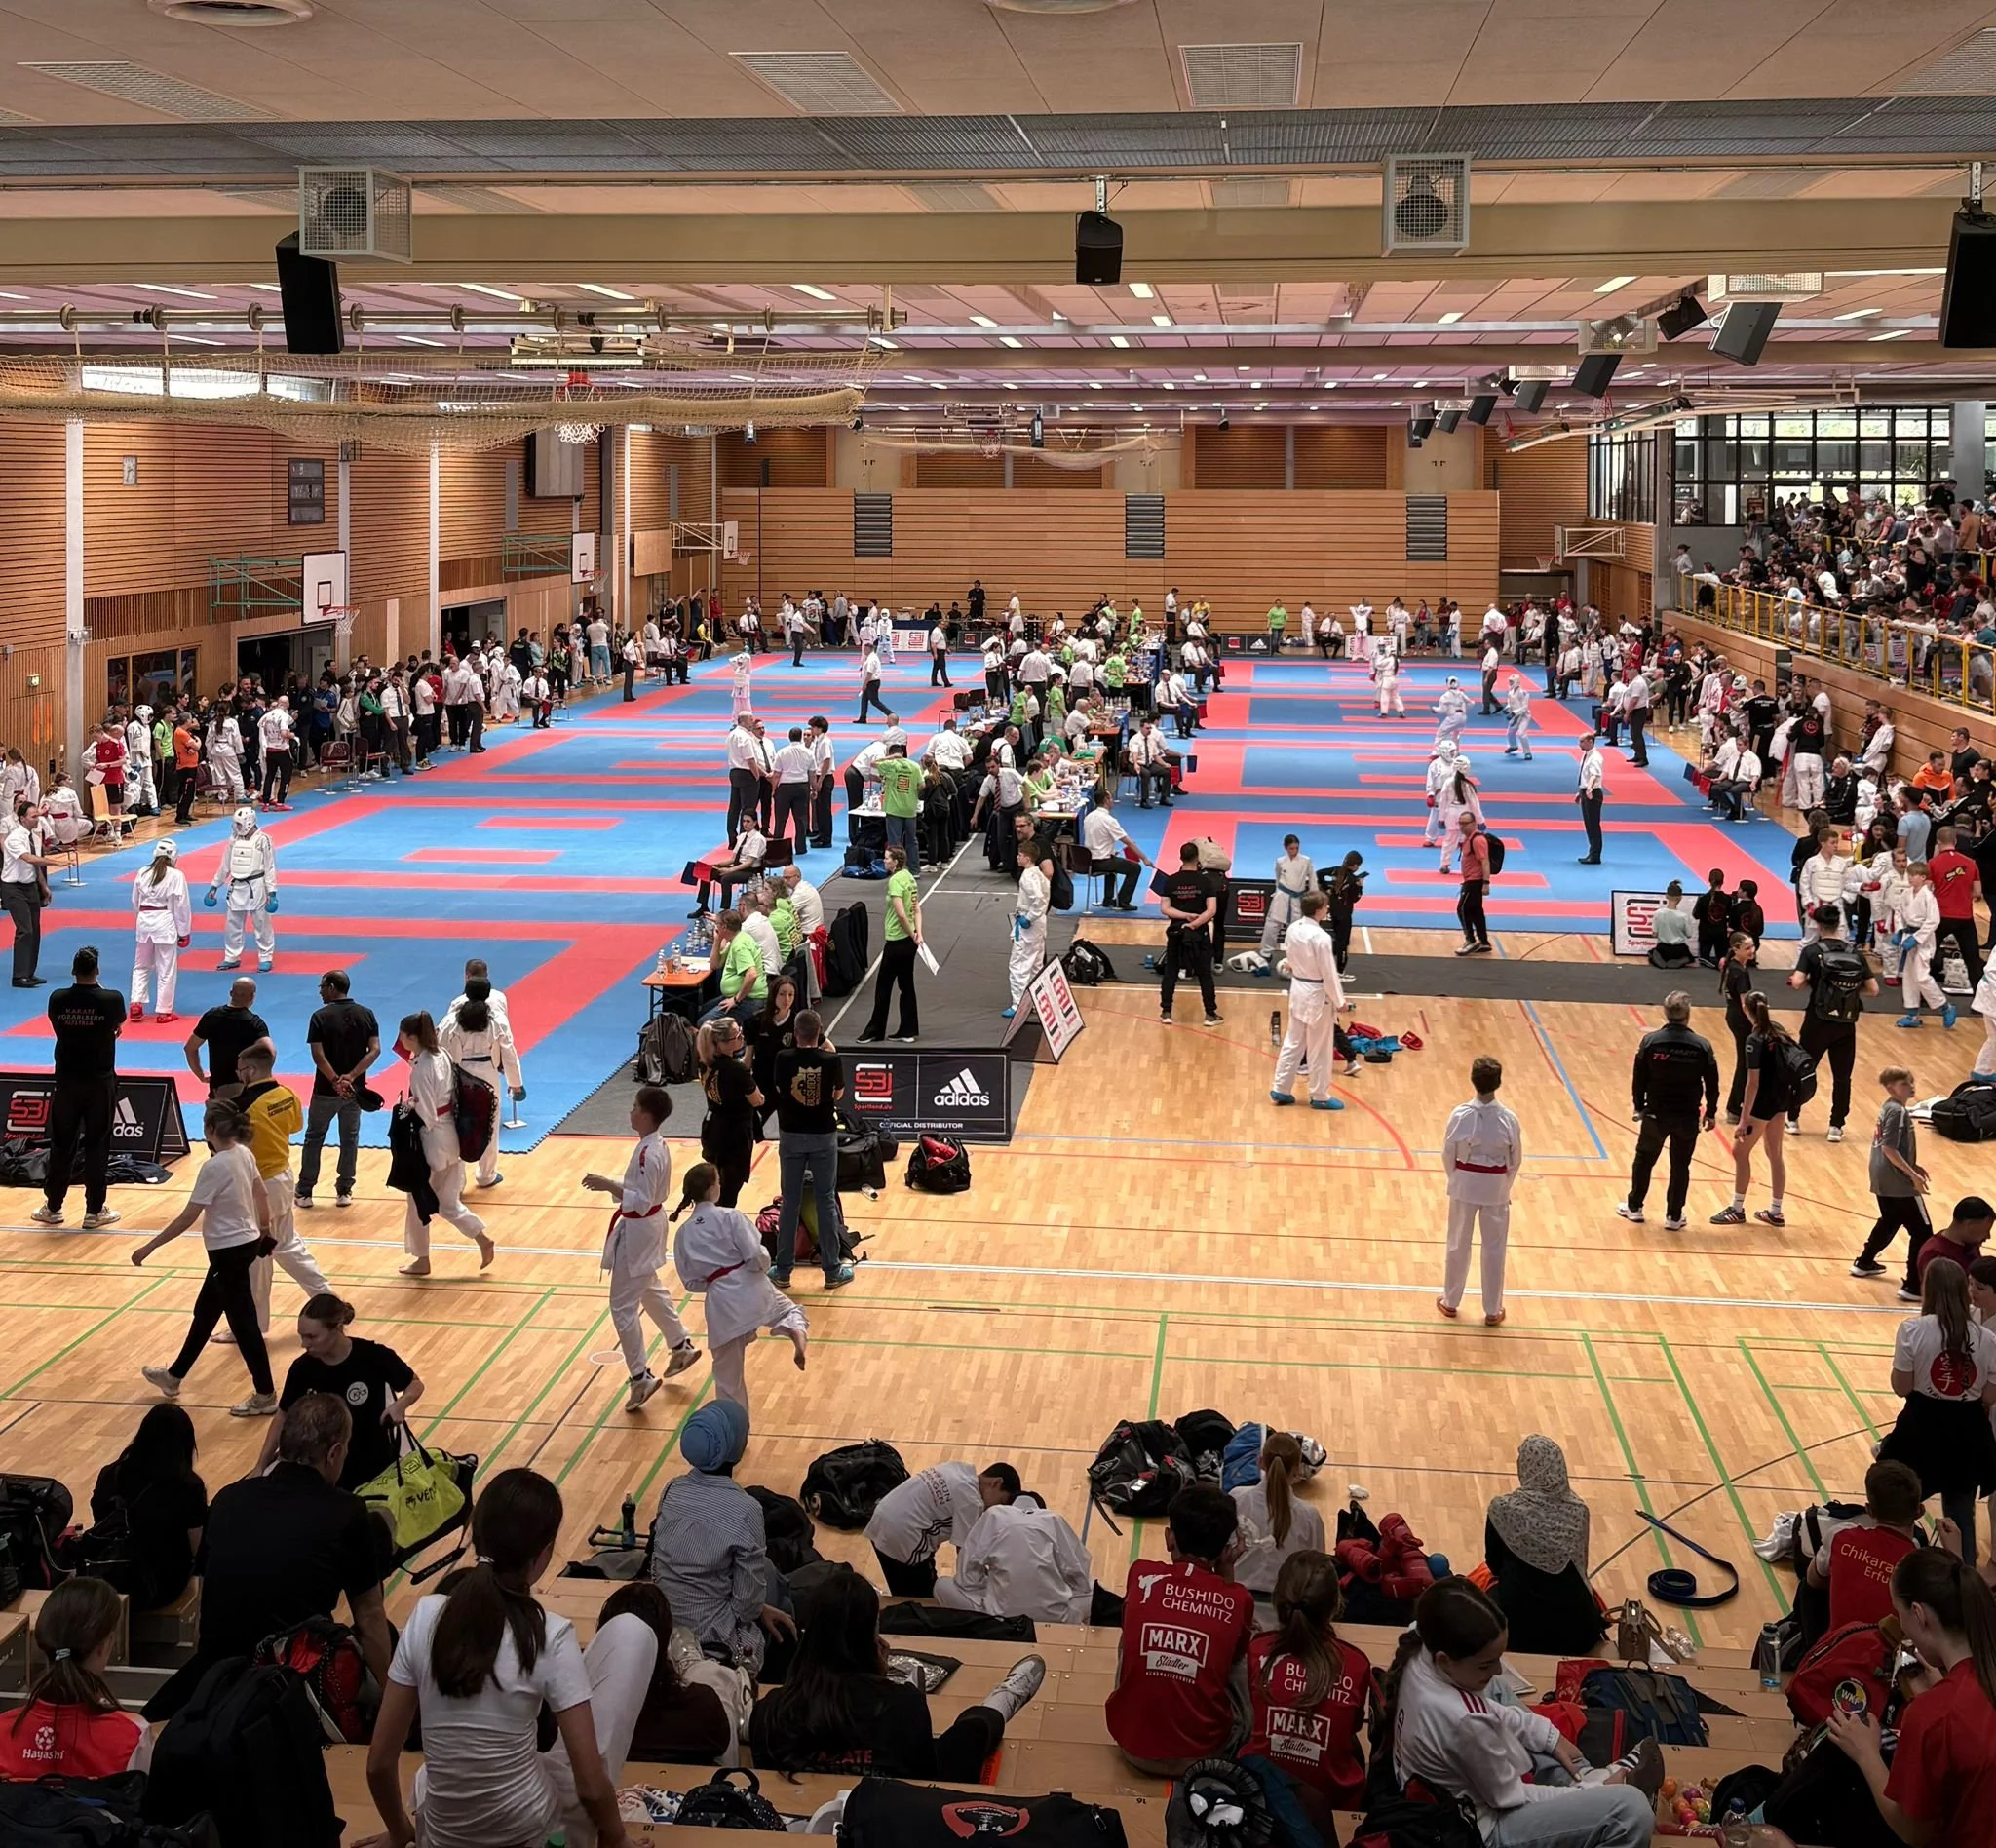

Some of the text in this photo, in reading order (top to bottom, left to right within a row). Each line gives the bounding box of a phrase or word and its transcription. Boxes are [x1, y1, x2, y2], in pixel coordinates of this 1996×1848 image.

[934, 1092, 990, 1106] adidas
[113, 1123, 144, 1137] das
[1840, 1543, 1895, 1573] Chikara
[1863, 1566, 1890, 1584] Erfu
[1165, 1583, 1235, 1610] BUSHIDO
[1162, 1598, 1232, 1624] CHEMNITZ
[1148, 1629, 1201, 1657] MARX
[22, 1748, 65, 1761] Hayashi
[1350, 1813, 1362, 1822] 15
